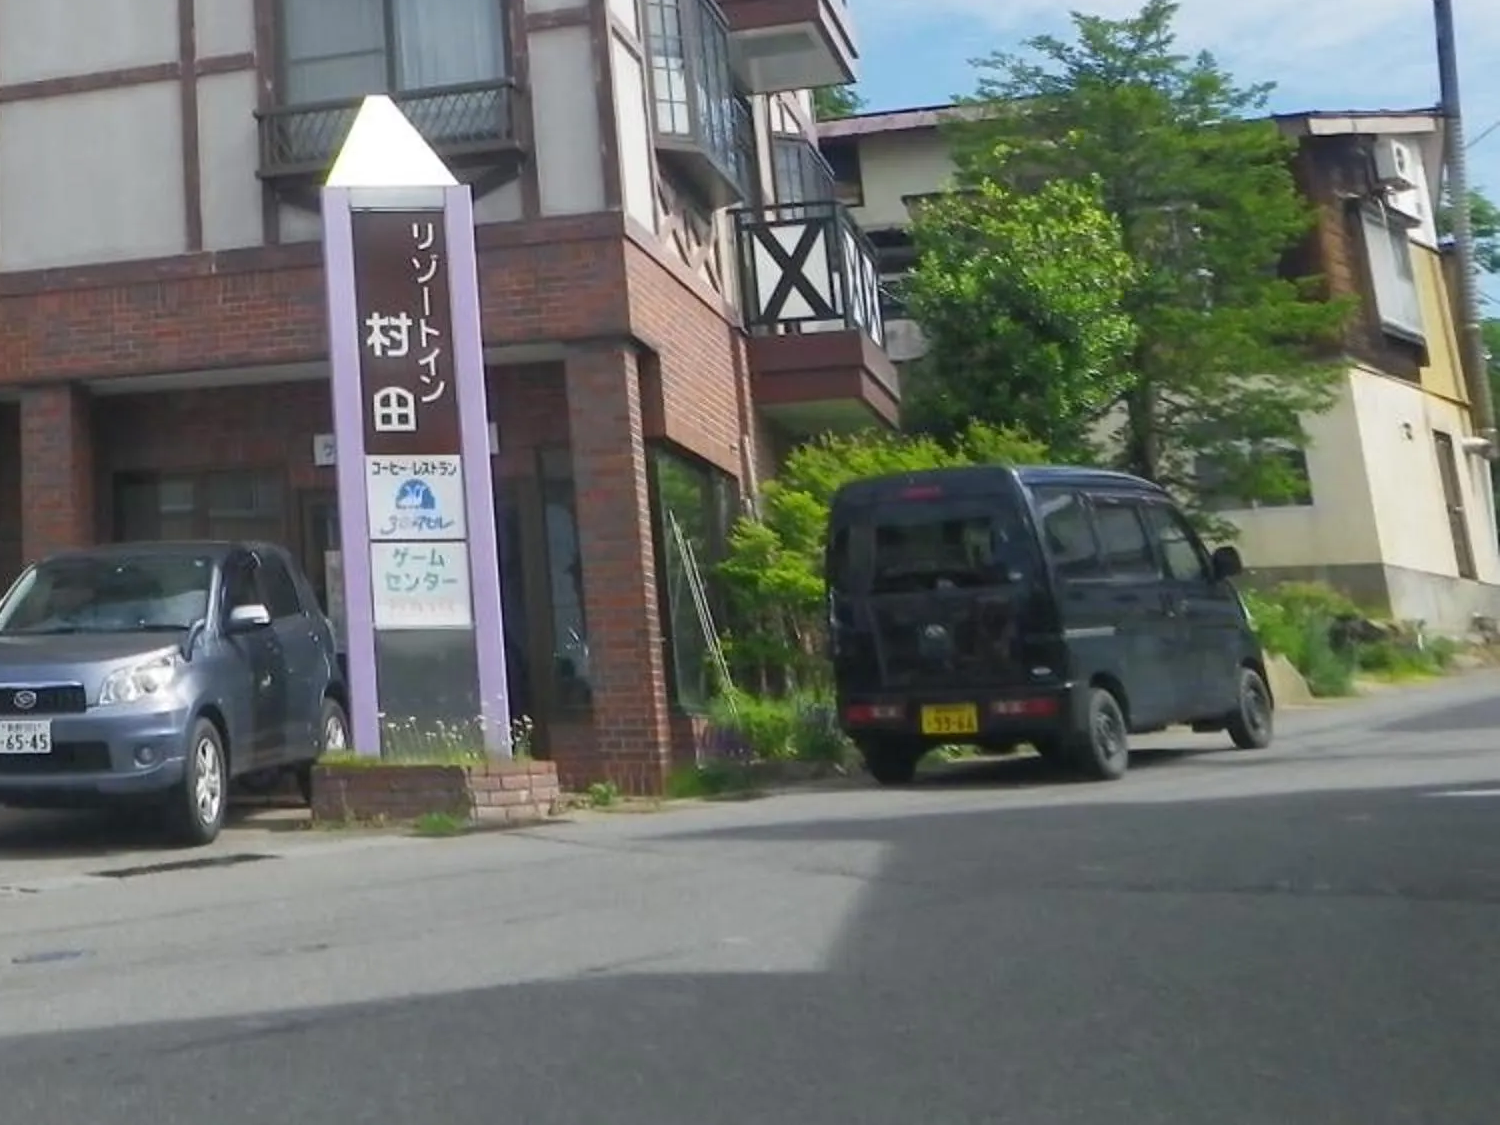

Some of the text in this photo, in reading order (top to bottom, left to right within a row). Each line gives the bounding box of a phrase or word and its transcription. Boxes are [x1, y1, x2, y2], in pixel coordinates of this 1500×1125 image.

[412, 222, 445, 402] リゾートイン
[392, 547, 445, 568] ゲーム
[385, 572, 458, 592] センター
